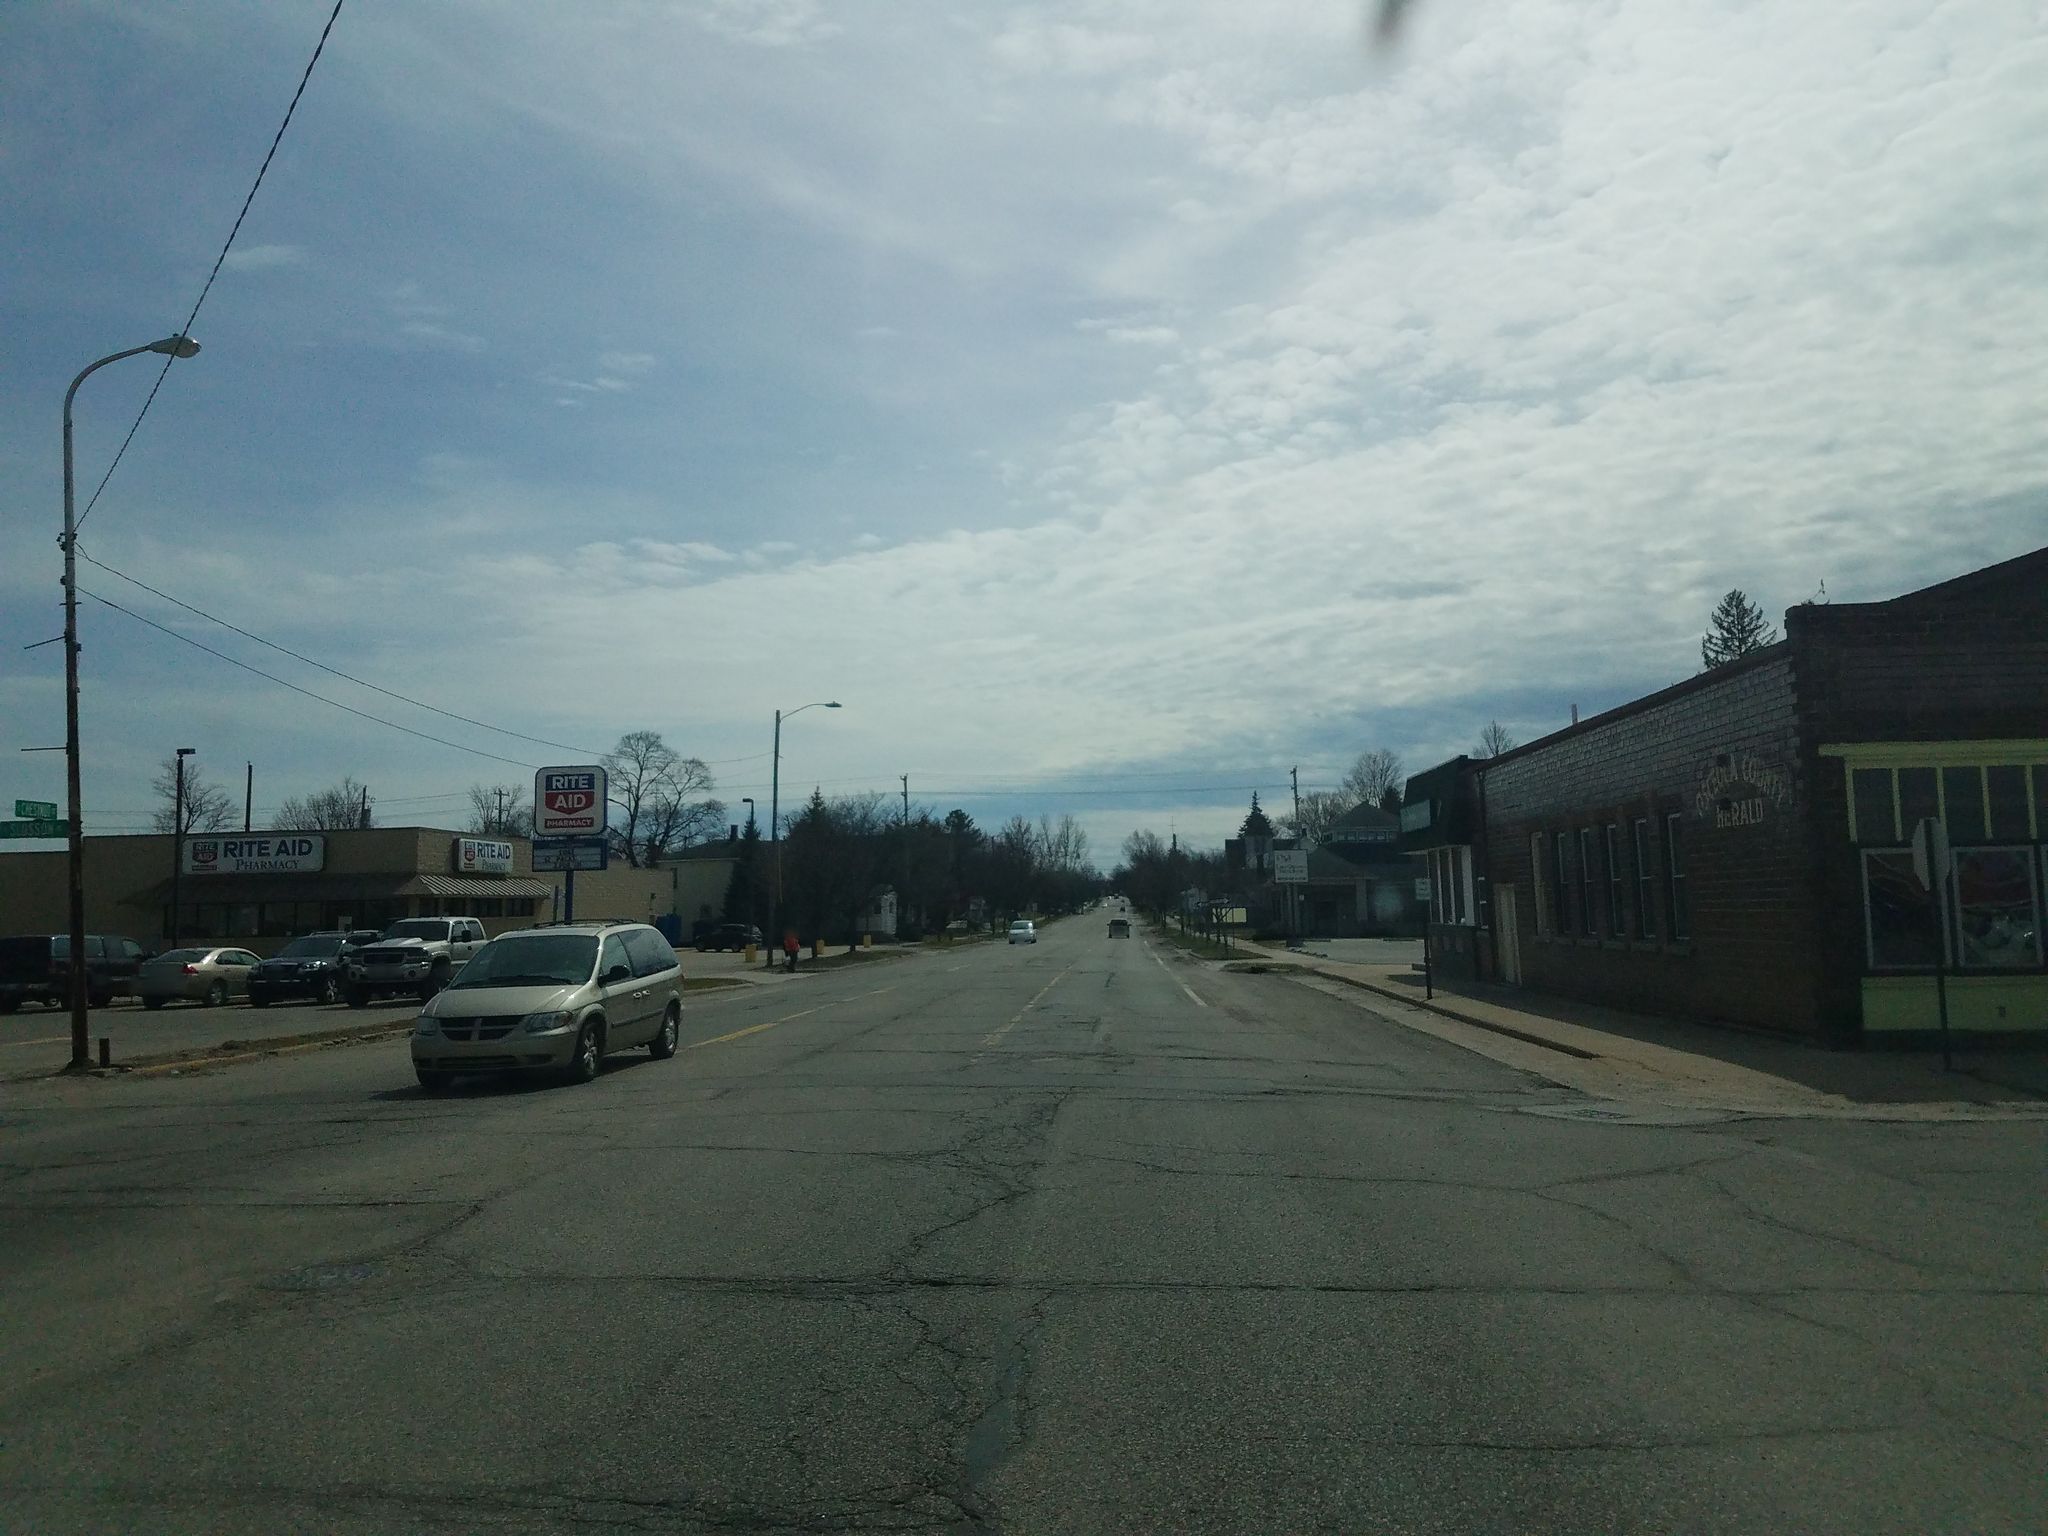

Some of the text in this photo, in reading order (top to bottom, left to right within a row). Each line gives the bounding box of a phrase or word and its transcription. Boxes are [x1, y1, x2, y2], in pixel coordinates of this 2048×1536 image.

[552, 775, 589, 789] RITE
[554, 794, 586, 809] AID
[546, 818, 592, 828] PHARMACY
[223, 839, 314, 858] RITE AID
[477, 842, 496, 859] RITE
[497, 844, 511, 860] AID
[236, 859, 299, 871] PHARMACY
